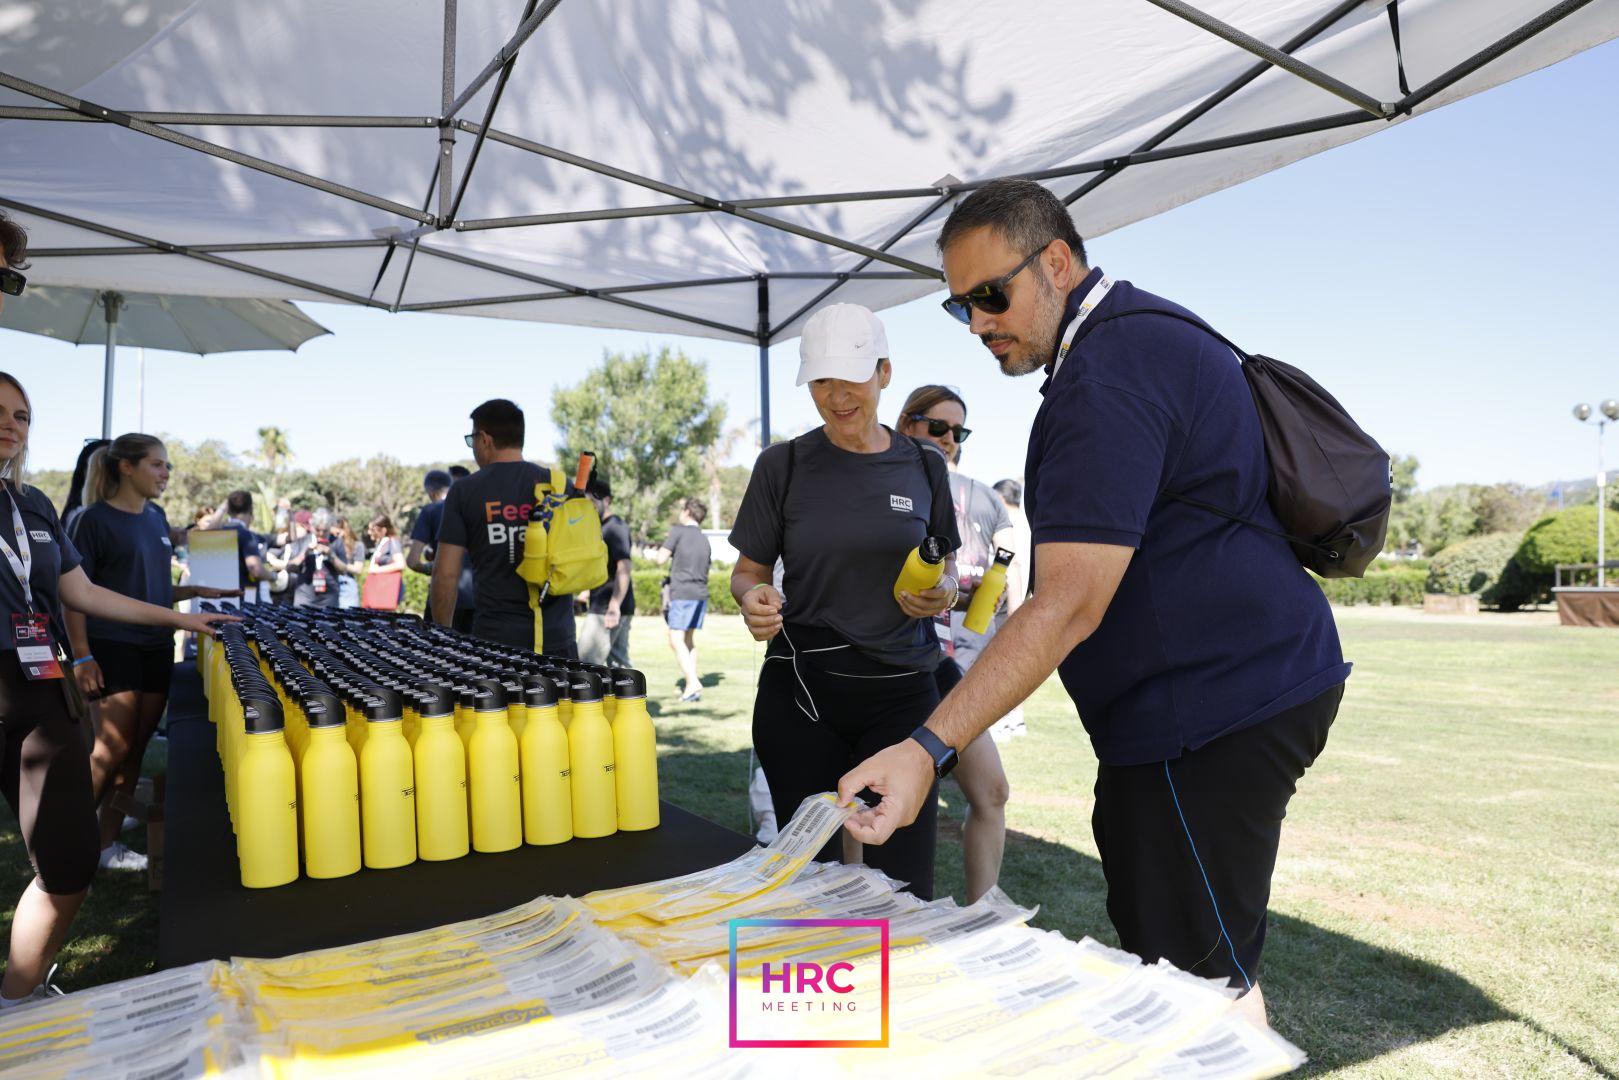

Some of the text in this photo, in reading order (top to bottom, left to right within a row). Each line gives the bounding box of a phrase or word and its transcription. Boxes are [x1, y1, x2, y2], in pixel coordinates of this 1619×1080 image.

[486, 501, 532, 522] Fee
[891, 496, 912, 508] HRC
[488, 523, 529, 550] Bra
